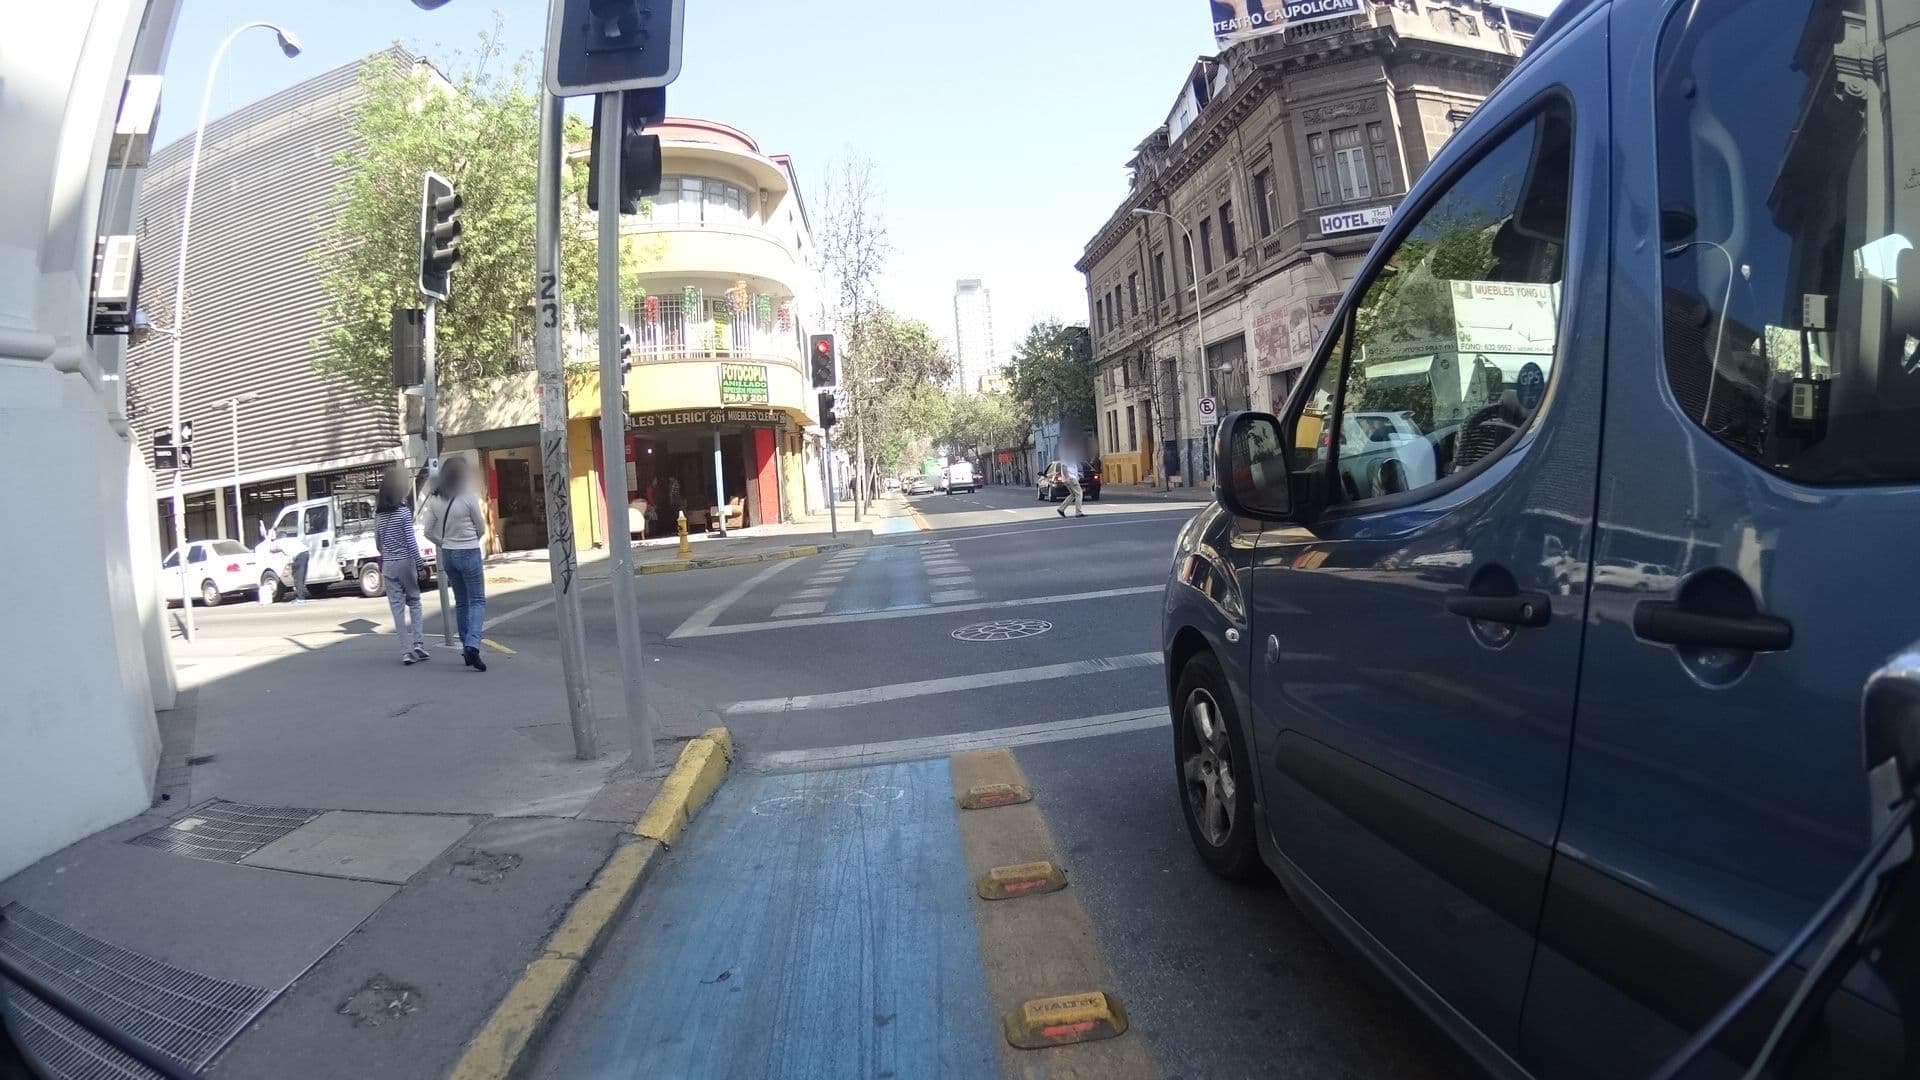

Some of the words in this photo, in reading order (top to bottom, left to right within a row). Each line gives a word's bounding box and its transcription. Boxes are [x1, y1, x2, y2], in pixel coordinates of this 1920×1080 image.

[1214, 14, 1262, 32] TEATRO
[1264, 0, 1354, 22] CAUPOLICAN
[1322, 213, 1369, 232] HOTEL
[1475, 285, 1514, 296] MUEBLES
[1516, 287, 1538, 298] YONG
[723, 364, 767, 381] FOTOCOPIA
[1521, 370, 1540, 385] GPS
[710, 414, 725, 424] 201
